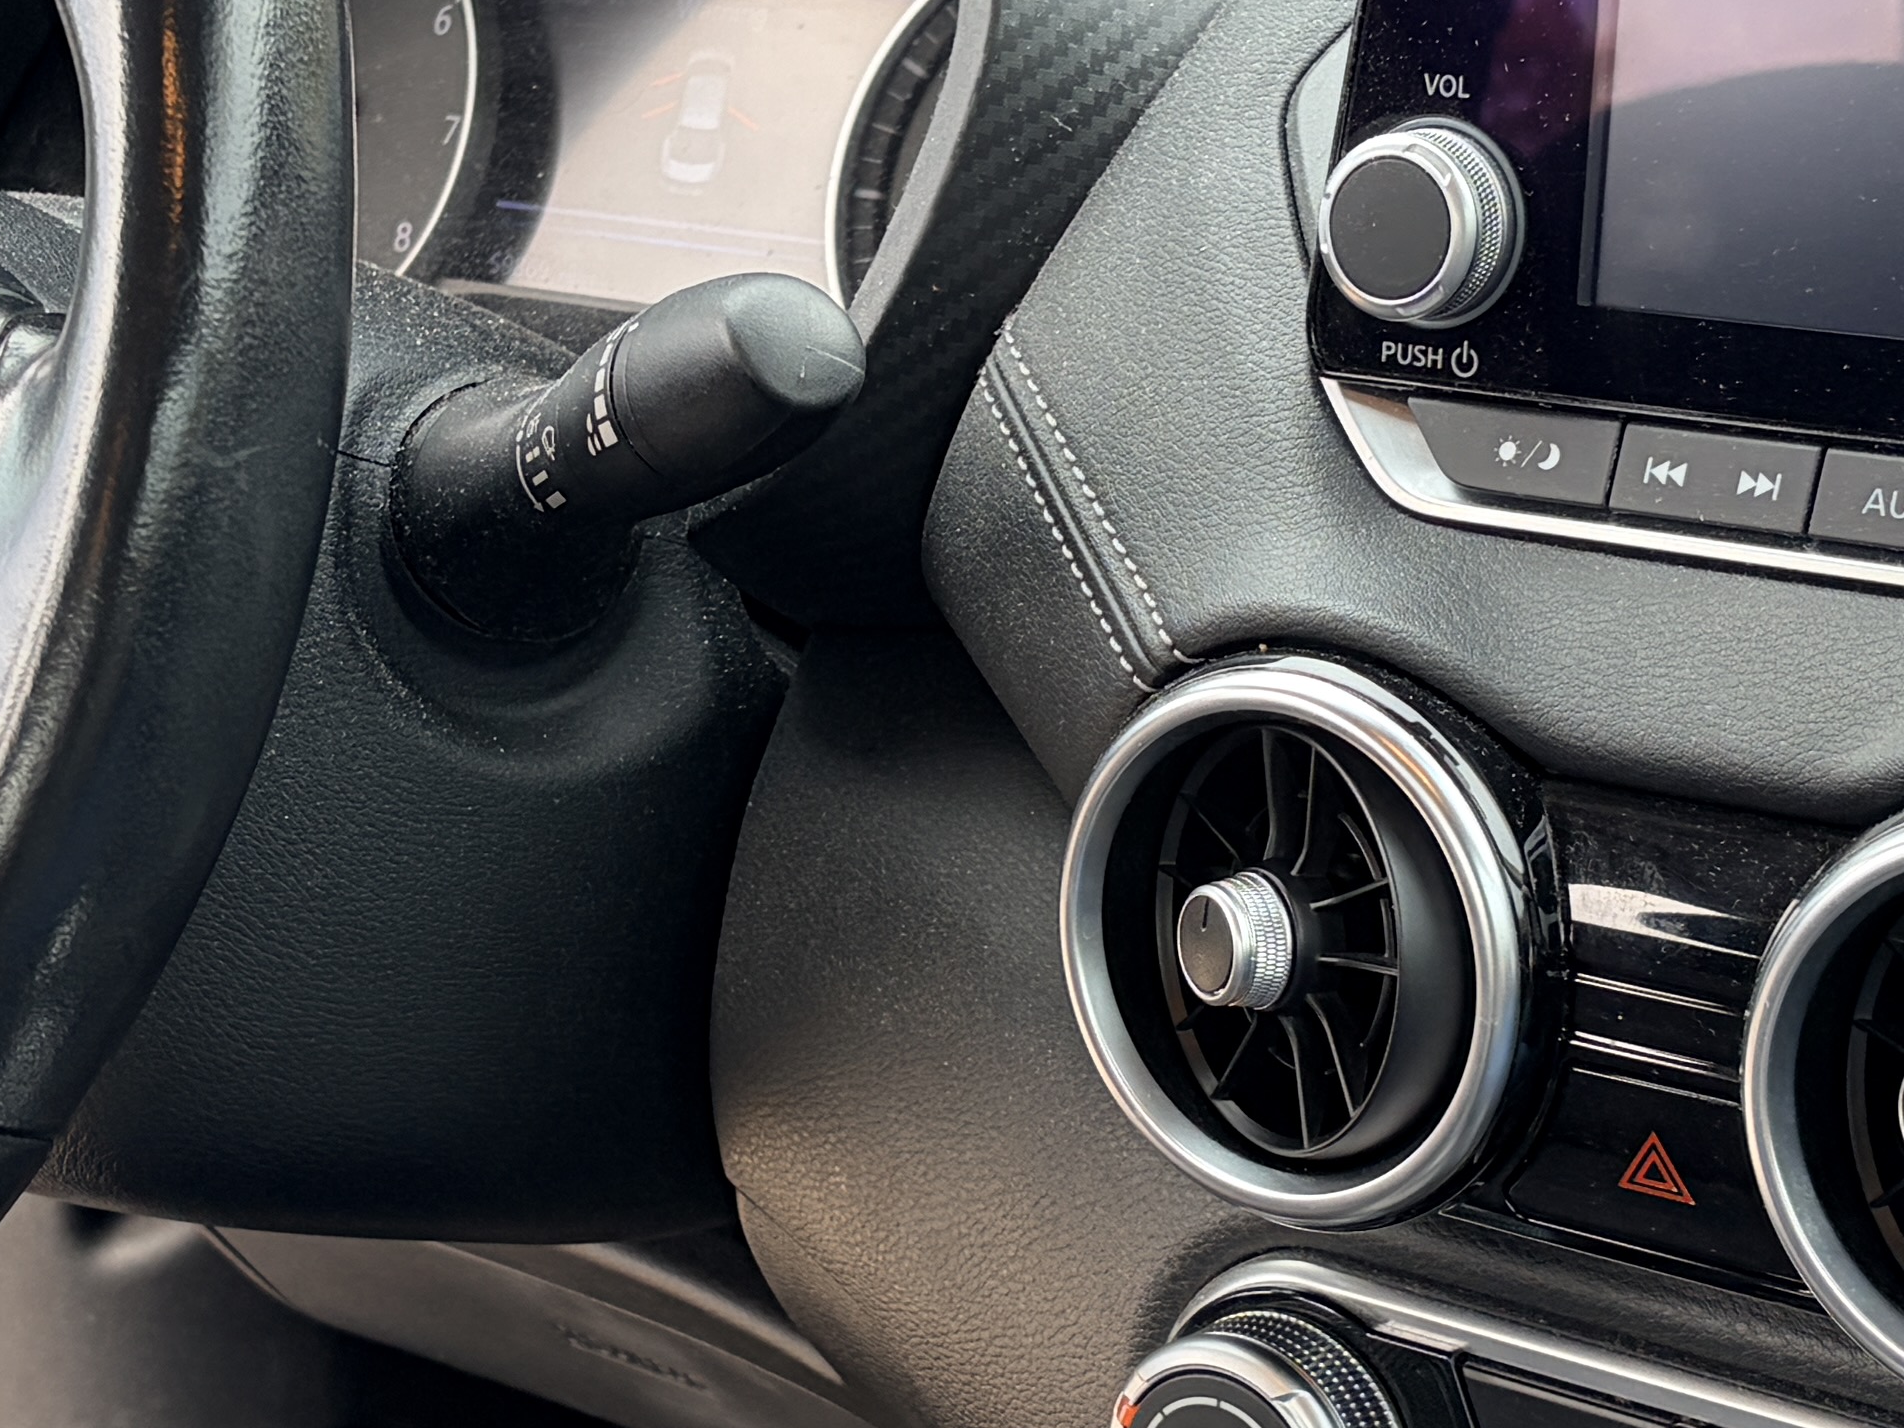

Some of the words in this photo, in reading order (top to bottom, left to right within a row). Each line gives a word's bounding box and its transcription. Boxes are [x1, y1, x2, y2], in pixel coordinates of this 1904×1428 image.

[433, 4, 454, 37] 6
[1424, 73, 1470, 99] VOL
[442, 115, 463, 147] 7
[393, 221, 414, 254] 8
[1381, 340, 1443, 370] PUSH
